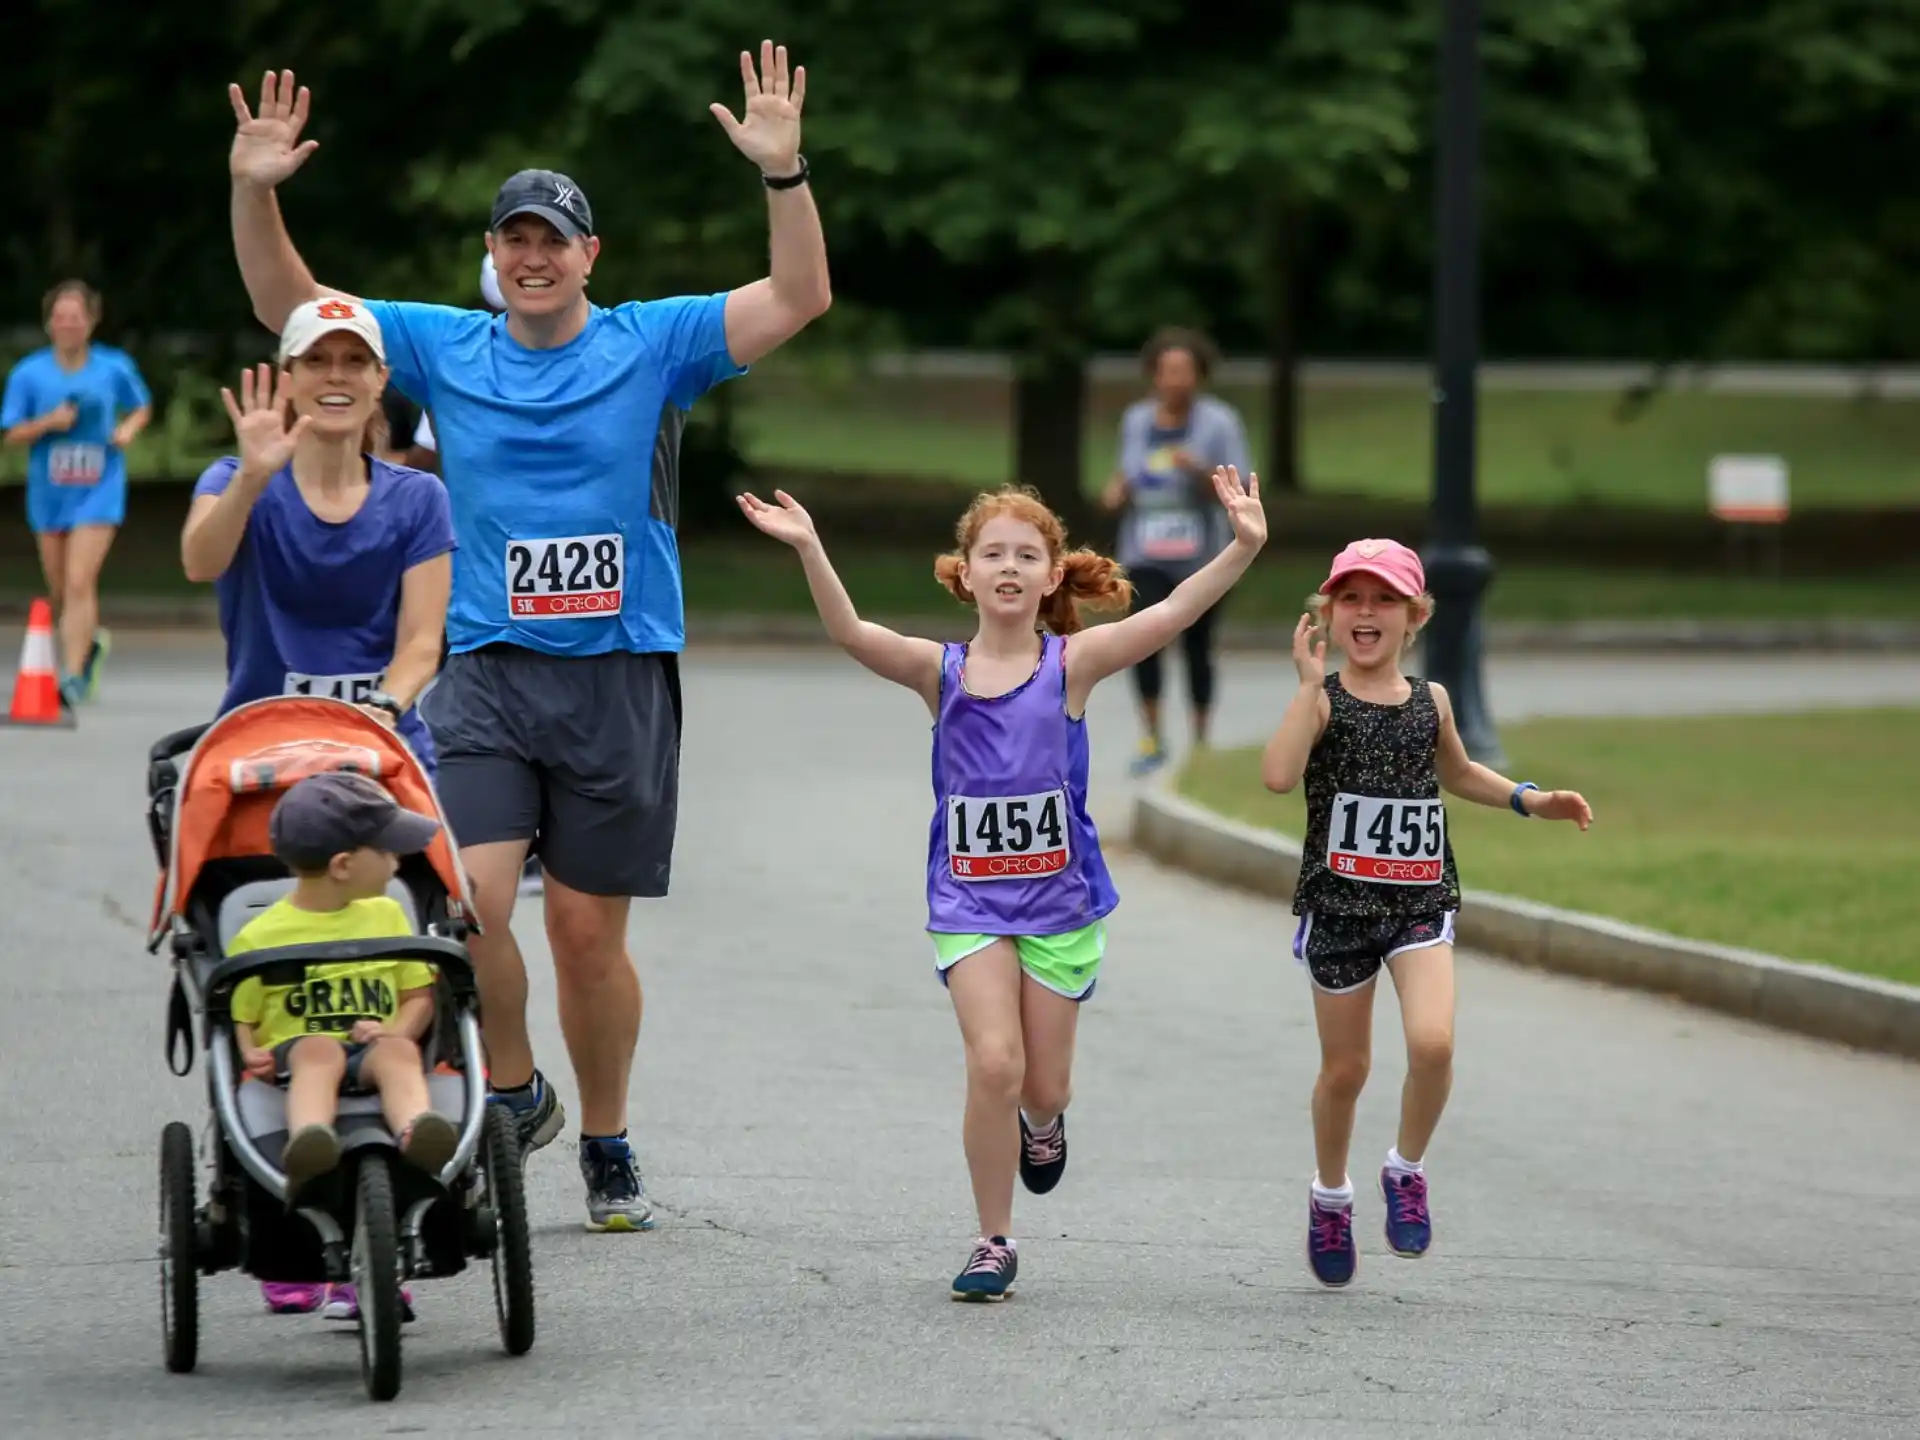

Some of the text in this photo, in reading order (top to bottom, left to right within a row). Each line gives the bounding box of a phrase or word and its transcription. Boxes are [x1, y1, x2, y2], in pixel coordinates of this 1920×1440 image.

[509, 539, 620, 593] 2428
[517, 599, 535, 613] 5K
[955, 796, 1062, 853] 1454
[1339, 800, 1441, 858] 1455
[956, 859, 972, 874] 5K
[1337, 856, 1356, 873] 5K
